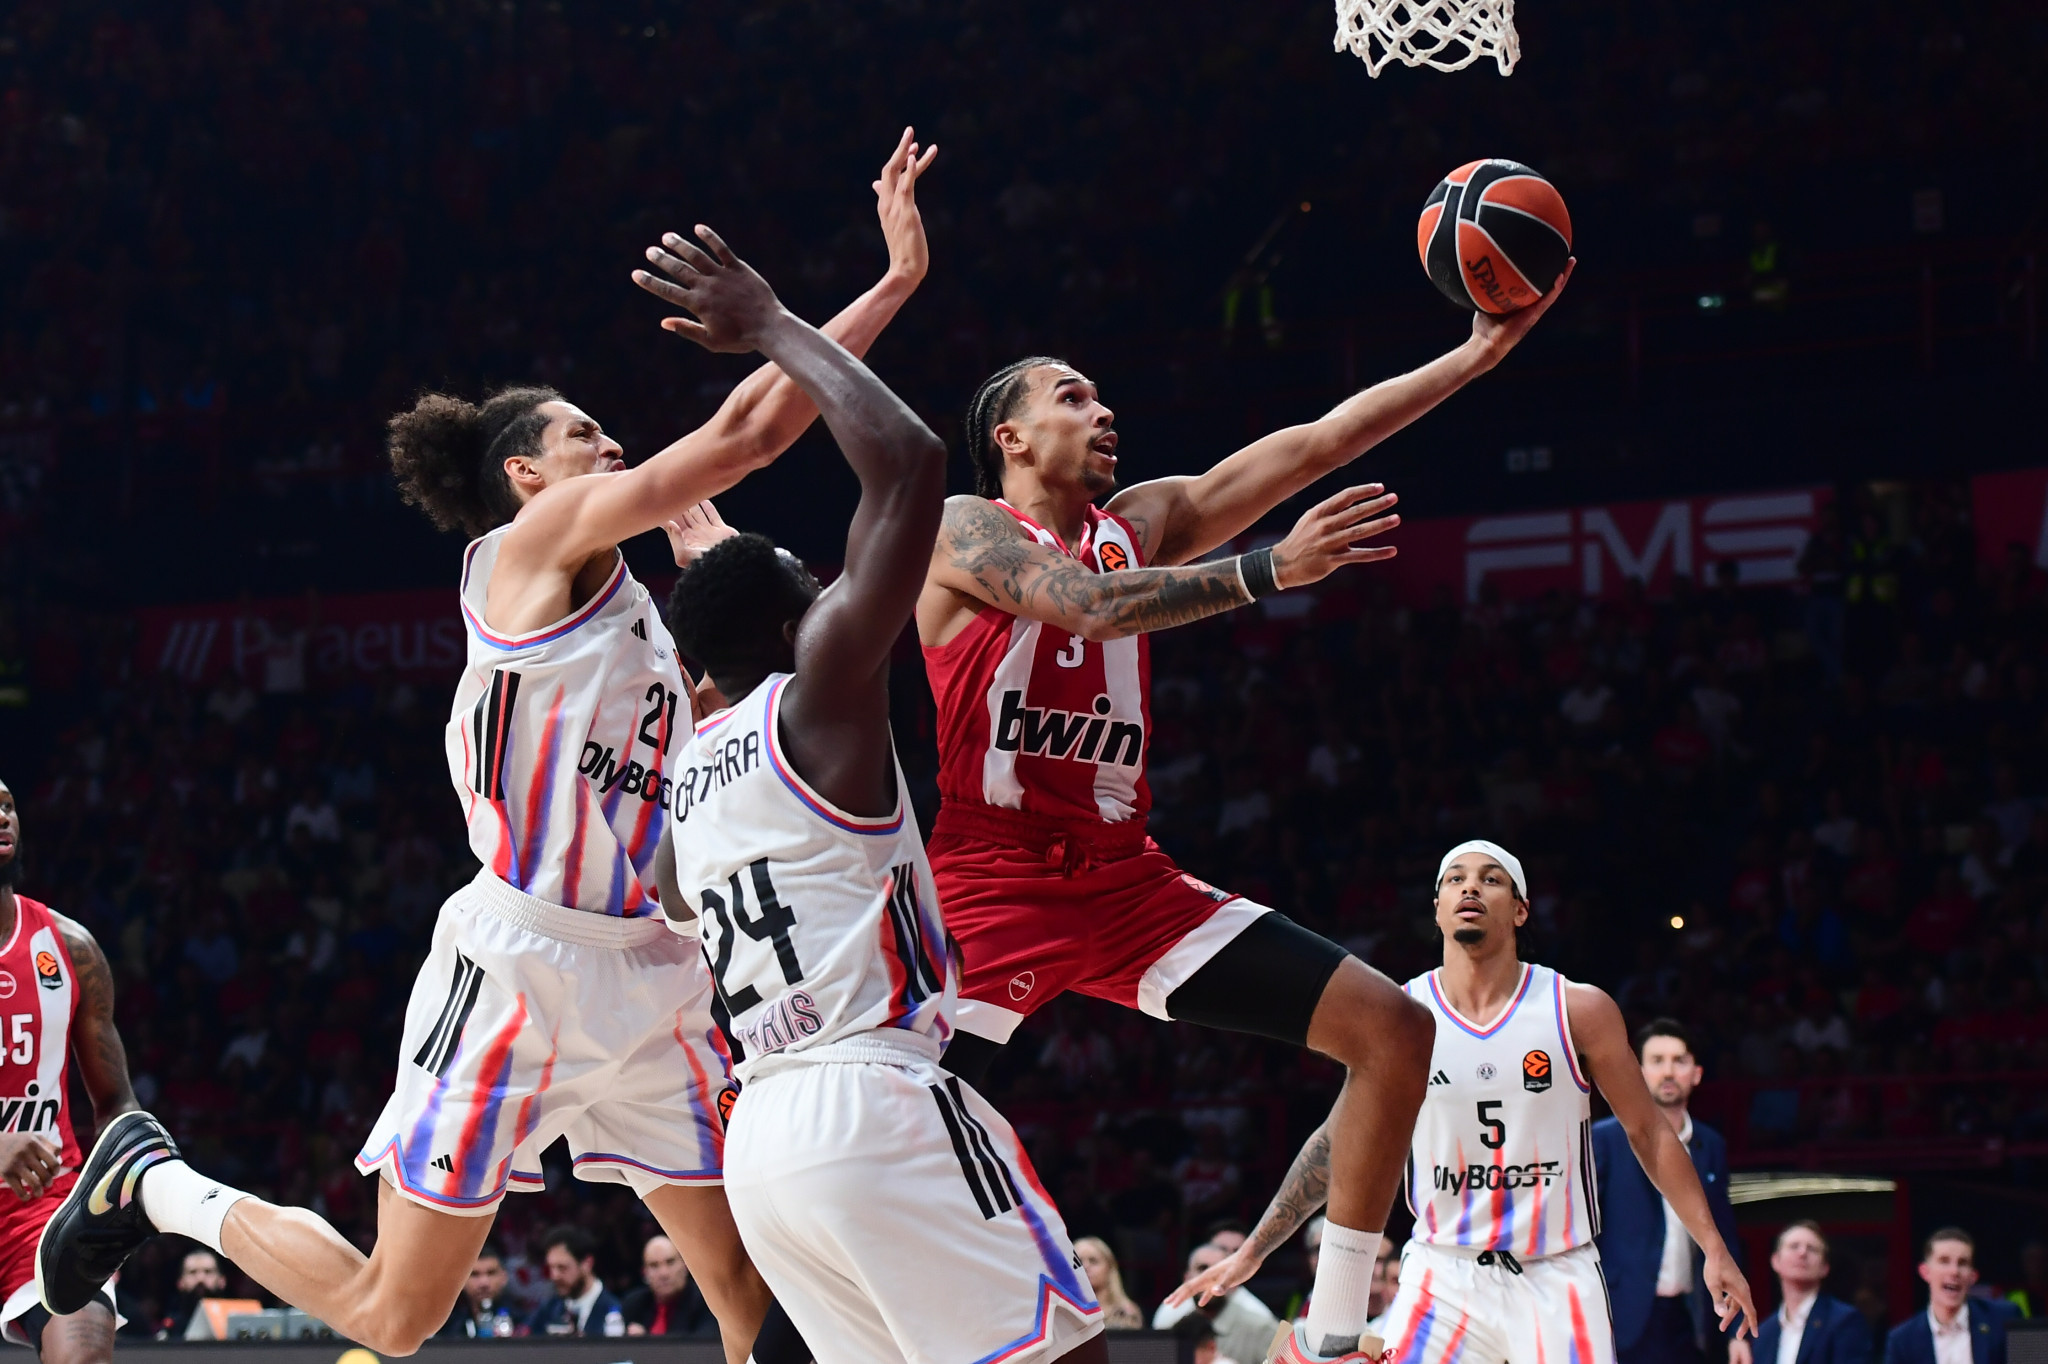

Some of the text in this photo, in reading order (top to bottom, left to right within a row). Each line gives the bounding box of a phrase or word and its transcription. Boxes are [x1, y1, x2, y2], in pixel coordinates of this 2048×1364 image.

[1464, 493, 1812, 604] FMS
[232, 615, 462, 682] Paeus
[1056, 633, 1085, 669] 3
[638, 681, 678, 757] 21
[994, 687, 1146, 768] bwin
[700, 856, 804, 1018] 24
[1477, 1100, 1506, 1149] 5
